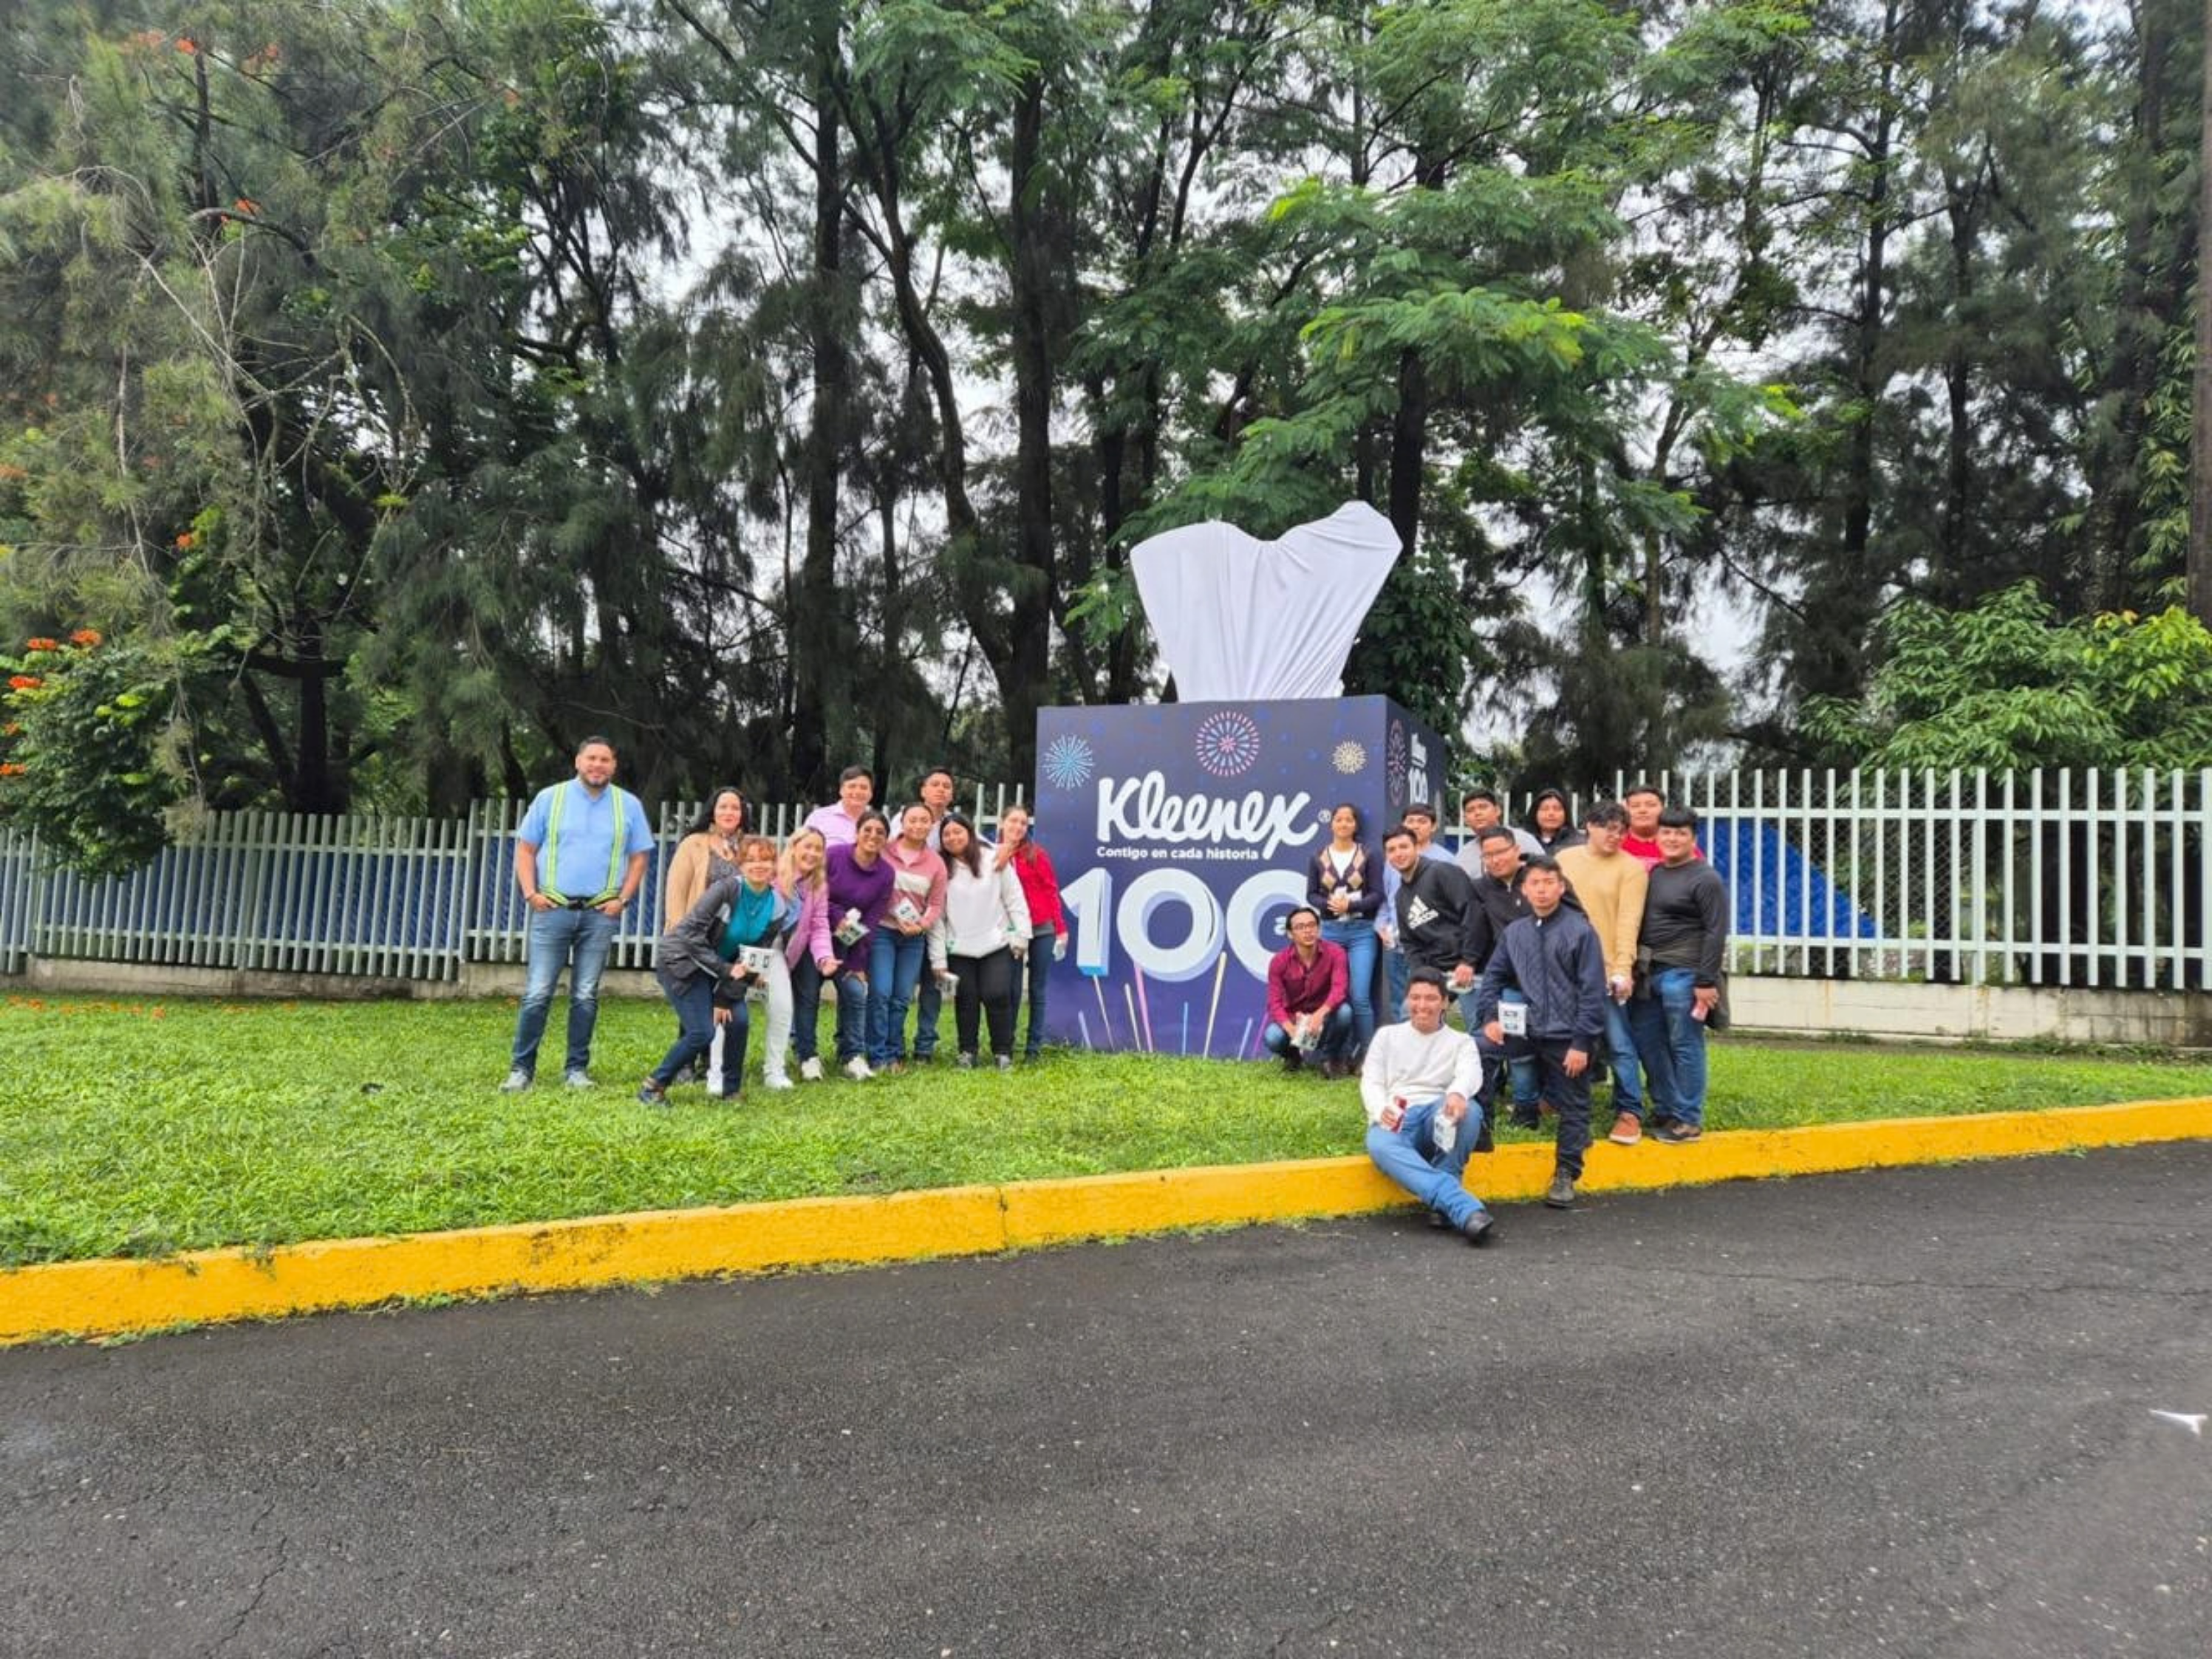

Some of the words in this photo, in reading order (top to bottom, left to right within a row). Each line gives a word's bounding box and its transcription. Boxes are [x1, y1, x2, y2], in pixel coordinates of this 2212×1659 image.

[1097, 770, 1319, 861] Kleenex
[1096, 846, 1148, 861] Contigo
[1151, 848, 1167, 858] en
[1170, 847, 1204, 859] cada
[1206, 847, 1260, 860] historia
